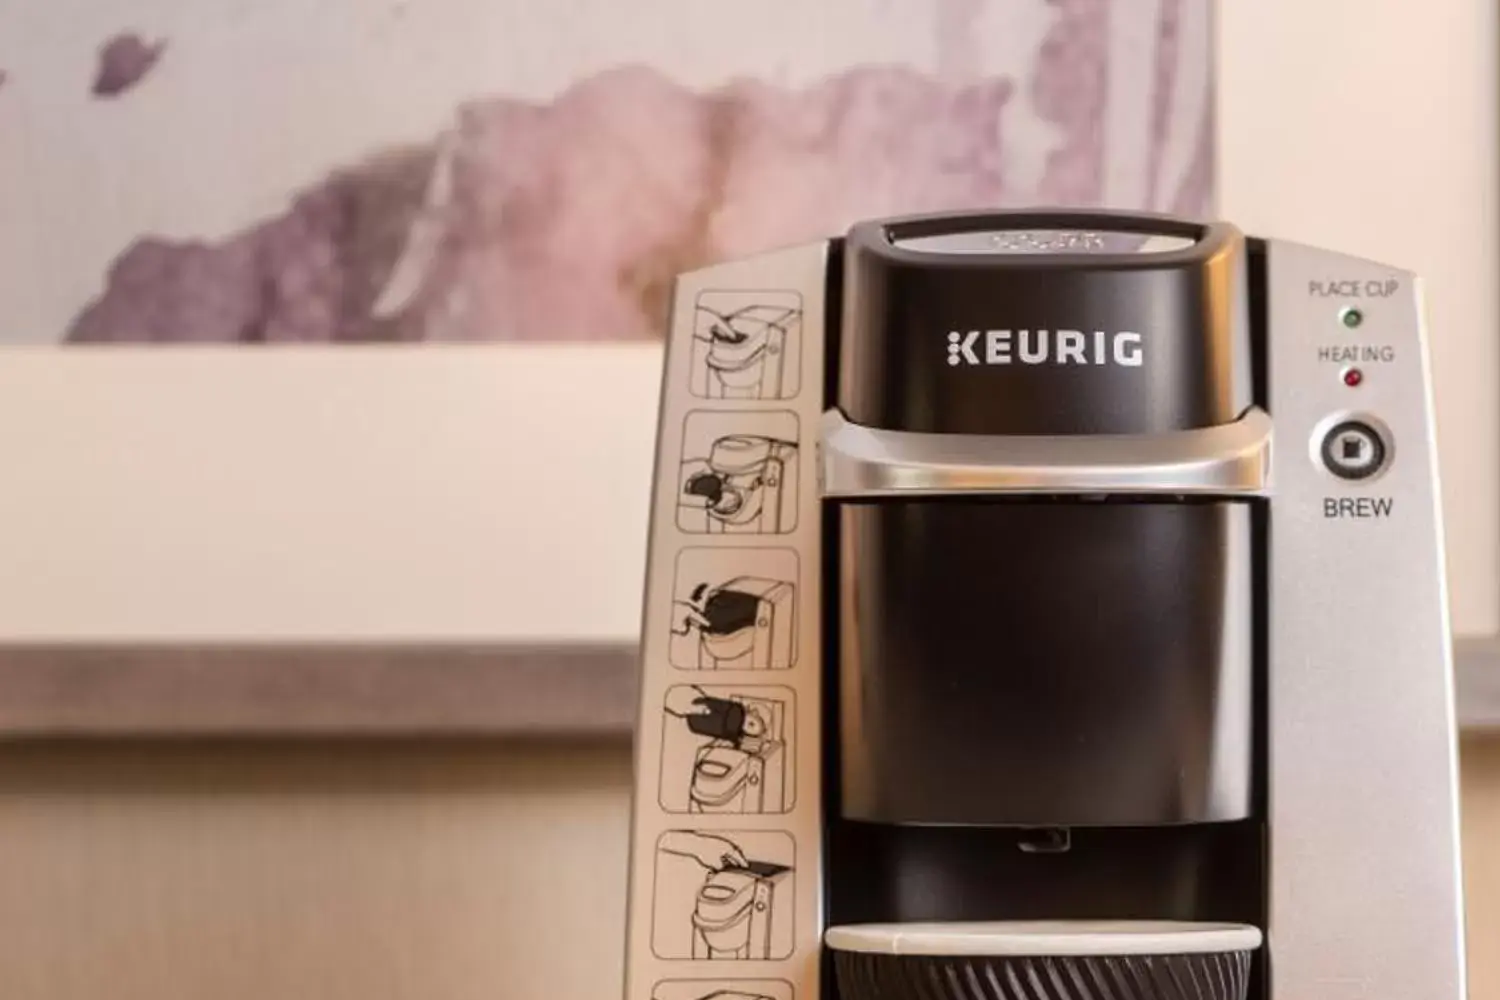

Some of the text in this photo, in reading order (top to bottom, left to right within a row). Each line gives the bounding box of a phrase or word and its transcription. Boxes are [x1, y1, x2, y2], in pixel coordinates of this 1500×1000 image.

[1308, 279, 1399, 297] PLACE CUP
[947, 329, 1143, 366] KEURIG
[1318, 345, 1394, 362] HEATING
[1323, 497, 1393, 518] BREW
